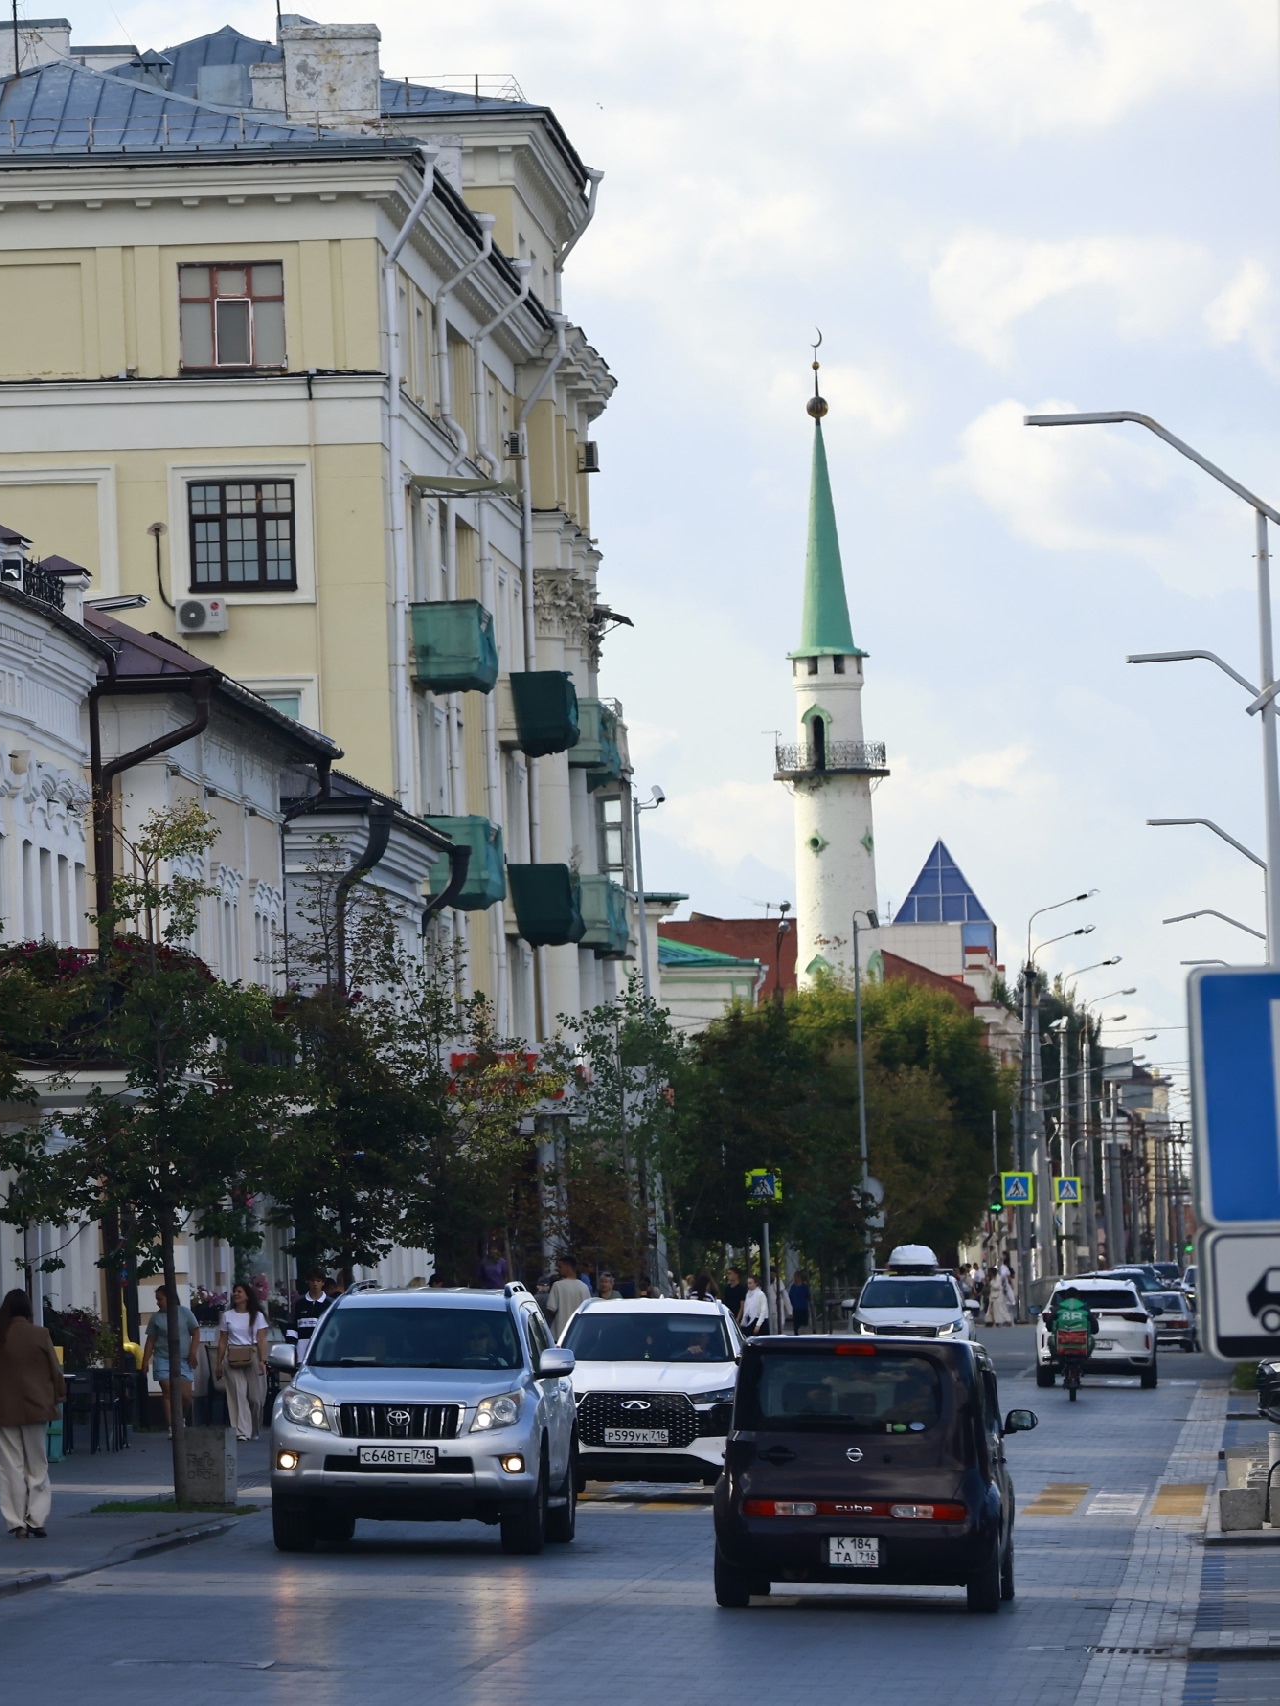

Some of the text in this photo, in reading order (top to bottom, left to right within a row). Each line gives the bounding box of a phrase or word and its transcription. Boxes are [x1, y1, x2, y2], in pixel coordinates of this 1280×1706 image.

[608, 1430, 666, 1442] Р599УК 716
[363, 1449, 432, 1463] С648ТЕ 716
[835, 1504, 873, 1512] cube
[837, 1537, 872, 1549] К 184
[835, 1552, 877, 1562] ТА 716
